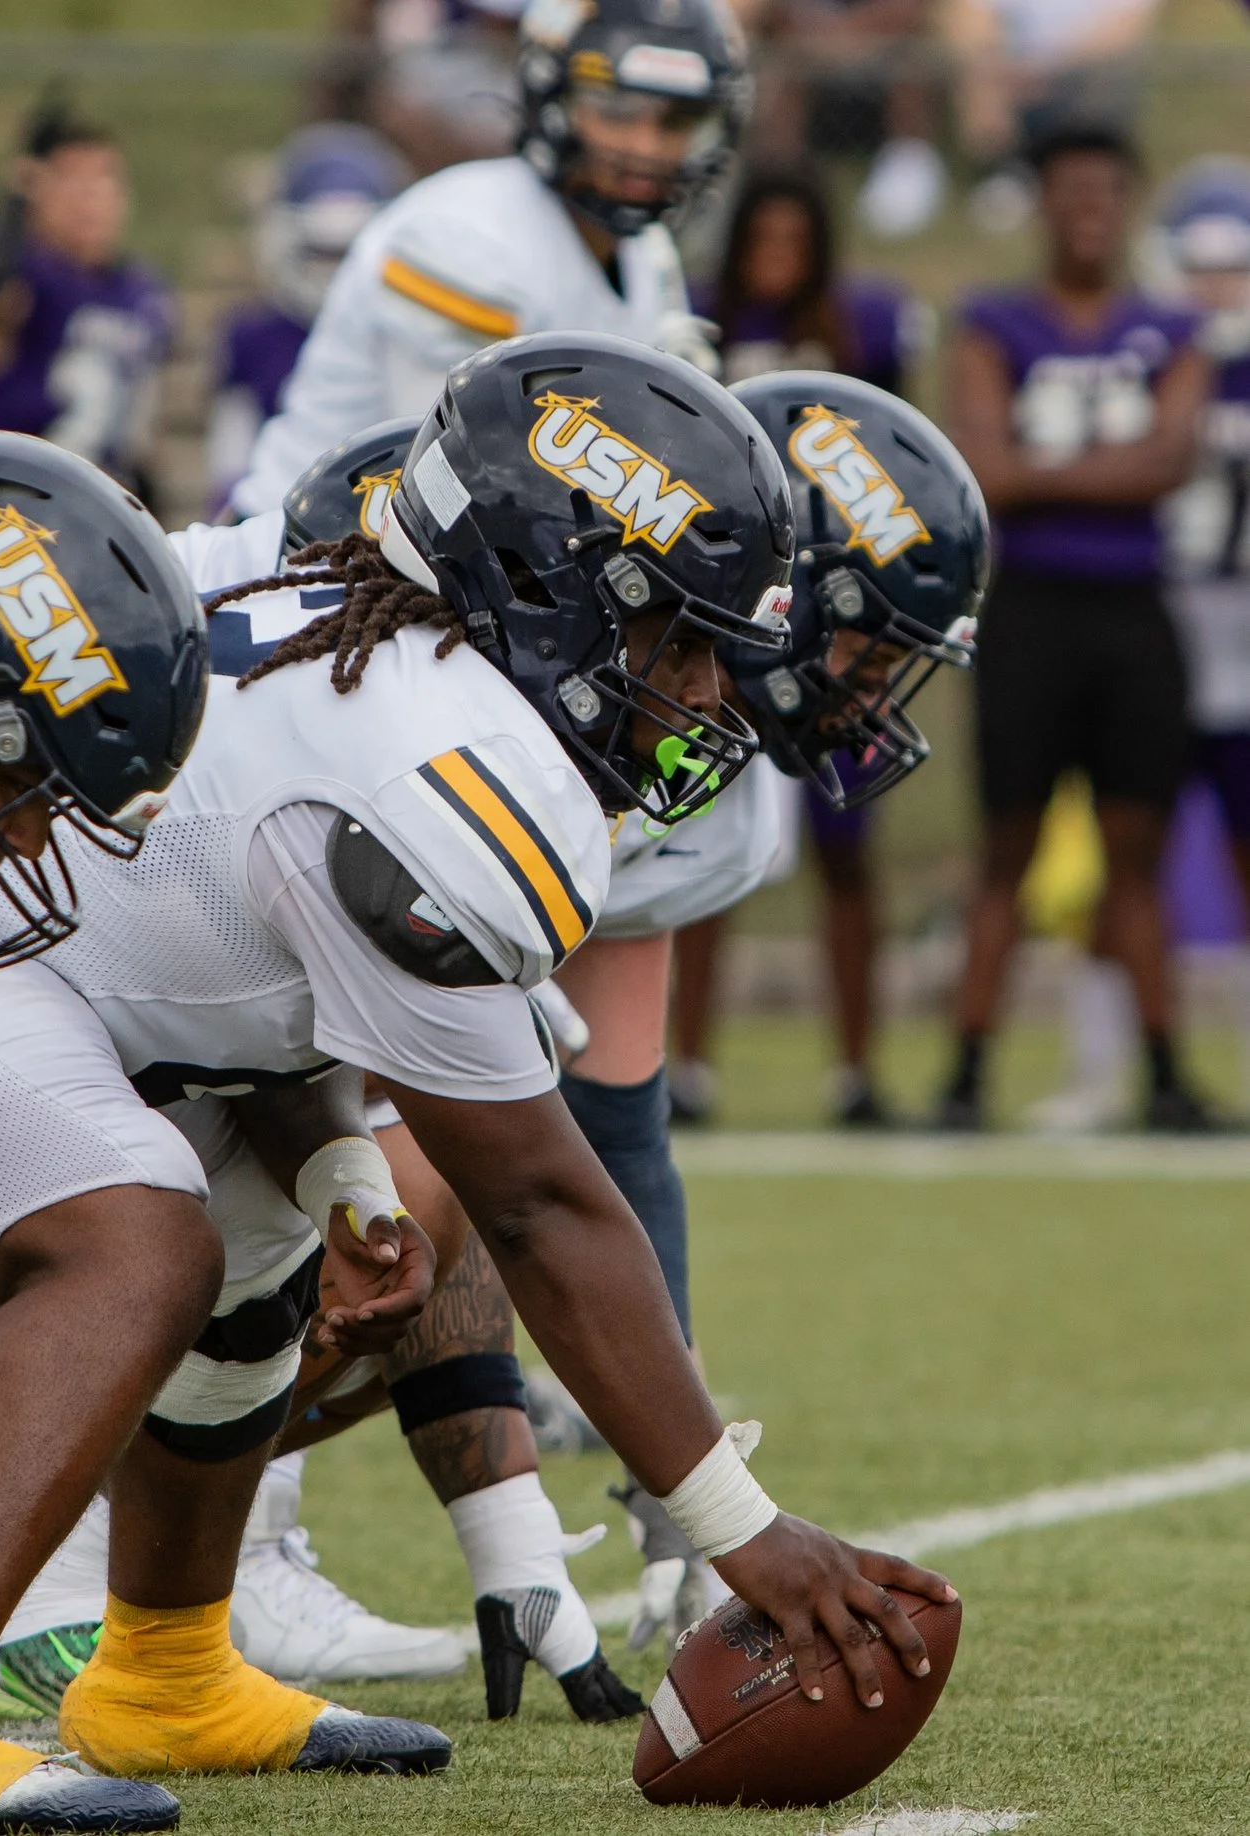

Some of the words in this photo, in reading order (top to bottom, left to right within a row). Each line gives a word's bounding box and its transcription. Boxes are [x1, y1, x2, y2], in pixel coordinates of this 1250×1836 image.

[529, 394, 714, 555] USM
[788, 410, 932, 568] USM
[731, 1670, 773, 1699] TEAM
[776, 1653, 795, 1673] ISS
